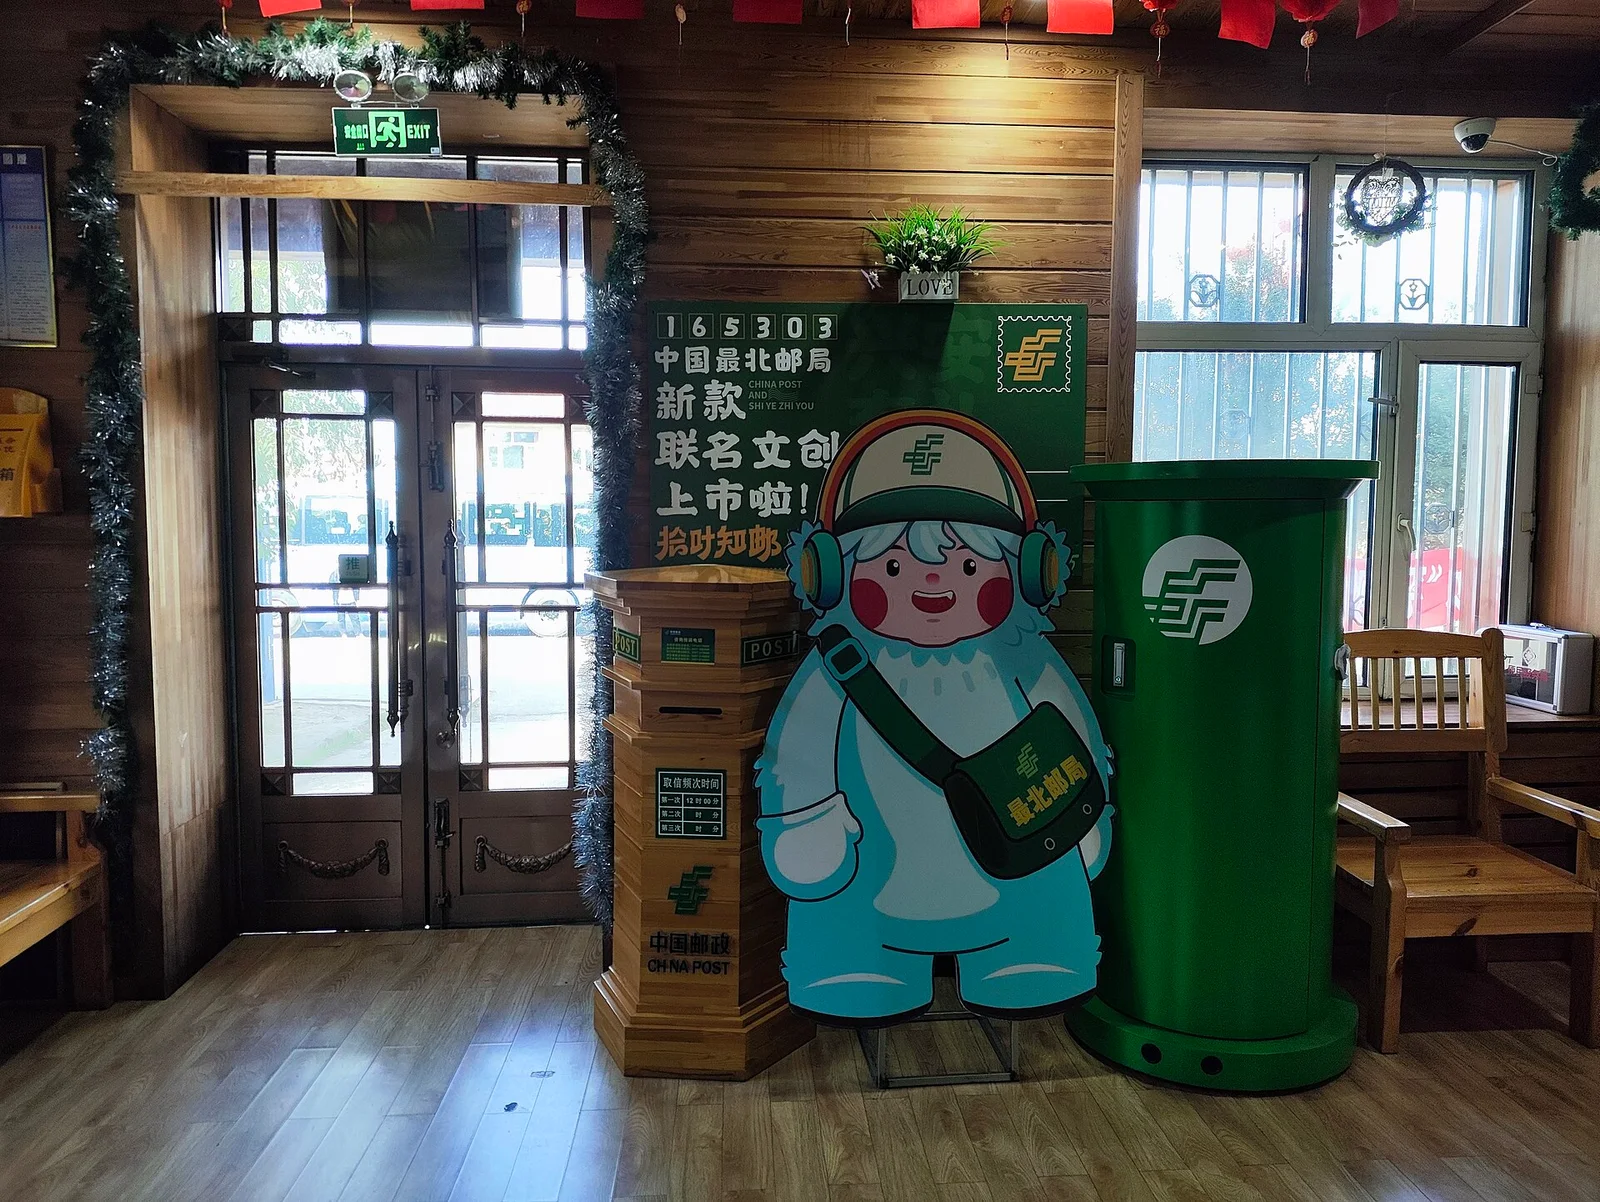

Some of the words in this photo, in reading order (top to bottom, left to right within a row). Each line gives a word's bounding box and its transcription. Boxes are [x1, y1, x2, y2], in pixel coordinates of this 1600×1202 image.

[1154, 24, 1166, 36] 福
[406, 124, 431, 139] EXIT
[906, 278, 954, 296] LOVE
[654, 345, 832, 375] 中国最北邮局
[748, 380, 777, 389] CHINA
[778, 380, 803, 389] POST
[656, 379, 747, 422] 新款
[748, 391, 768, 400] AND
[748, 402, 764, 411] SHI
[764, 402, 777, 411] YE
[778, 402, 794, 411] ZHI
[795, 402, 814, 411] YOU
[654, 428, 840, 471] 联名文创
[346, 556, 360, 571] 推
[615, 633, 636, 656] POST
[751, 638, 793, 659] POST
[663, 776, 720, 790] 取信频次时间
[1006, 754, 1088, 827] 最北邮局
[661, 796, 681, 804] 第一次
[661, 810, 681, 818] 第二次
[695, 811, 702, 819] 时
[712, 811, 719, 819] 分
[661, 824, 681, 832] 第三次
[695, 825, 702, 833] 时
[712, 825, 719, 833] 分
[650, 931, 730, 955] 中国邮政
[693, 960, 730, 975] POST
